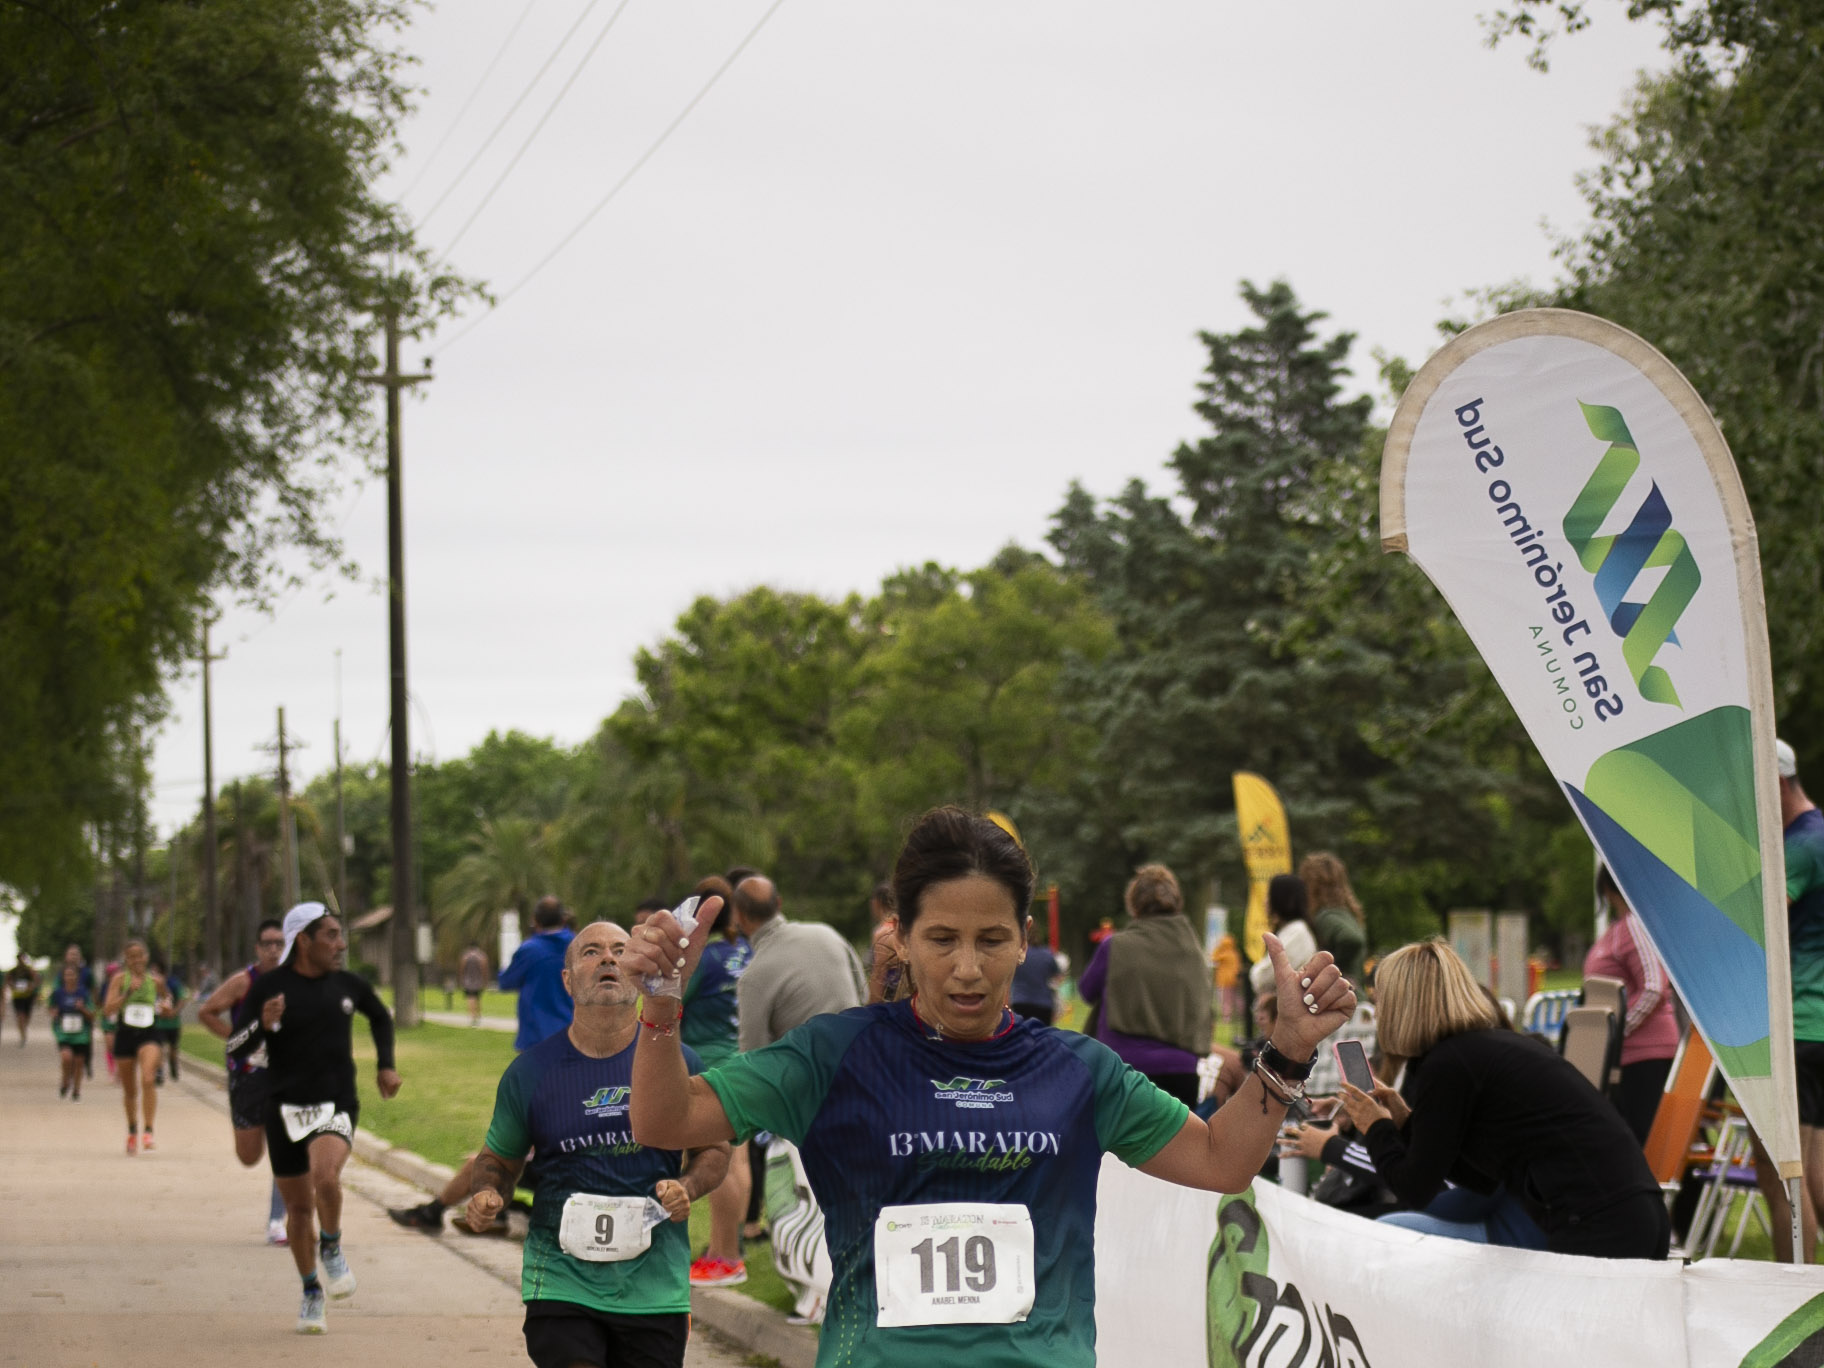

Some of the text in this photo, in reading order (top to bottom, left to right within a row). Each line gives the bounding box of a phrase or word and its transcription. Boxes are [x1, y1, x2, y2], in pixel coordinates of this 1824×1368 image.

[996, 1092, 1014, 1102] Sud
[920, 1131, 1062, 1156] MARATON
[918, 1145, 1033, 1174] Saludable
[594, 1213, 614, 1245] 9
[911, 1235, 997, 1294] 119
[931, 1295, 981, 1306] ANABEL MENNA
